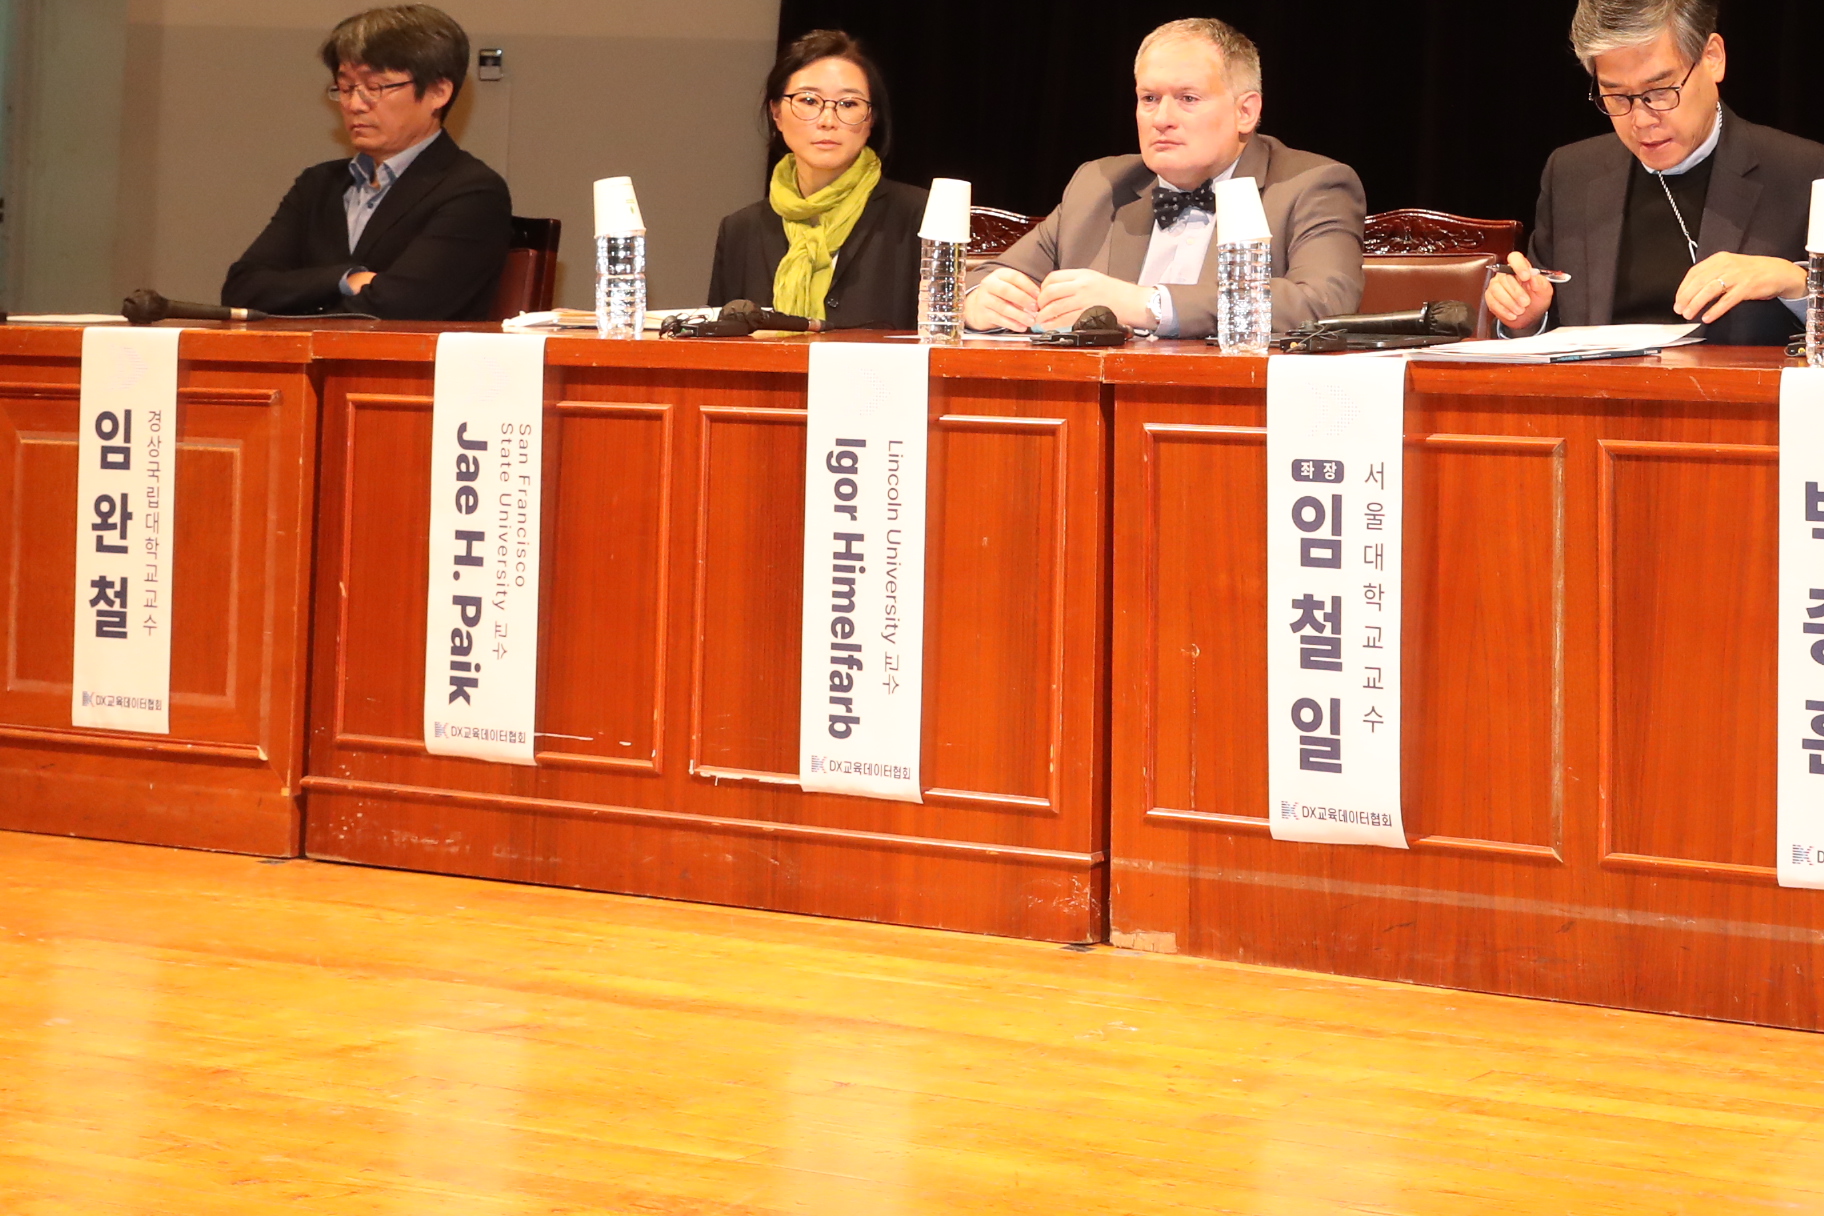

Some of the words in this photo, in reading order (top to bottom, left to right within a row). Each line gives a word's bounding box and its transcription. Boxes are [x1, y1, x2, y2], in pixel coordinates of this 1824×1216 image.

[455, 421, 488, 515] Jae
[500, 423, 514, 482] State
[518, 424, 531, 464] San
[825, 438, 867, 522] Igor
[887, 440, 904, 521] Lincoln
[452, 529, 486, 581] H.
[492, 493, 512, 610] University
[515, 475, 531, 587] Francisco
[880, 529, 902, 644] University
[448, 594, 483, 706] Paik
[493, 621, 509, 661] 교수
[828, 531, 866, 740] Himelfarb
[881, 650, 902, 695] 교수
[95, 694, 162, 711] DX교육데이터협회
[450, 725, 526, 744] DX교육데이터협회
[829, 759, 911, 780] DX교육데이터협회
[1301, 805, 1393, 827] DX교육데이터협회
